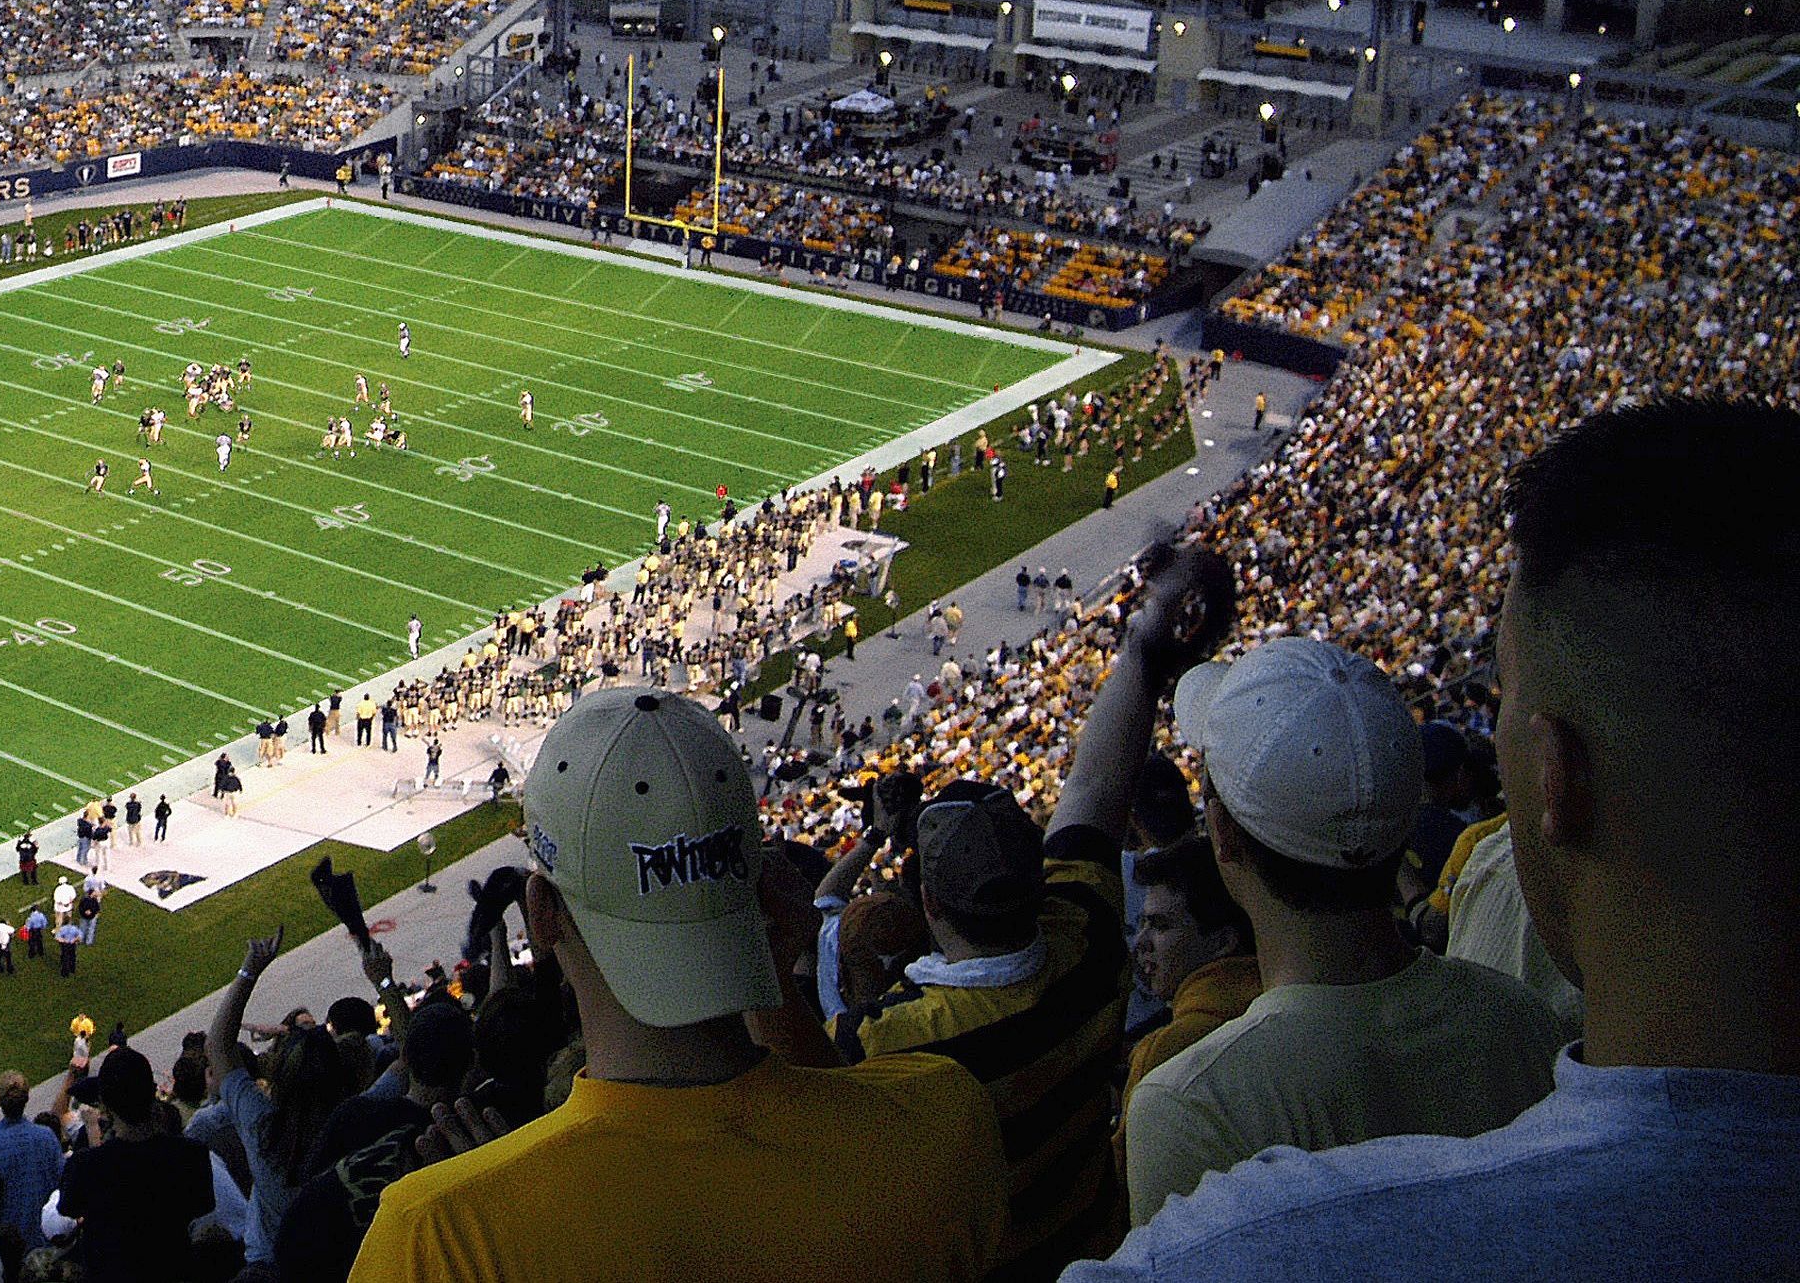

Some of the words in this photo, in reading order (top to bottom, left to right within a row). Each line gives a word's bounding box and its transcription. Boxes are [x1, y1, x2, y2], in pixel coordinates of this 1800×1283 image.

[312, 504, 372, 530] 40
[159, 558, 233, 587] 50
[11, 618, 78, 645] 40
